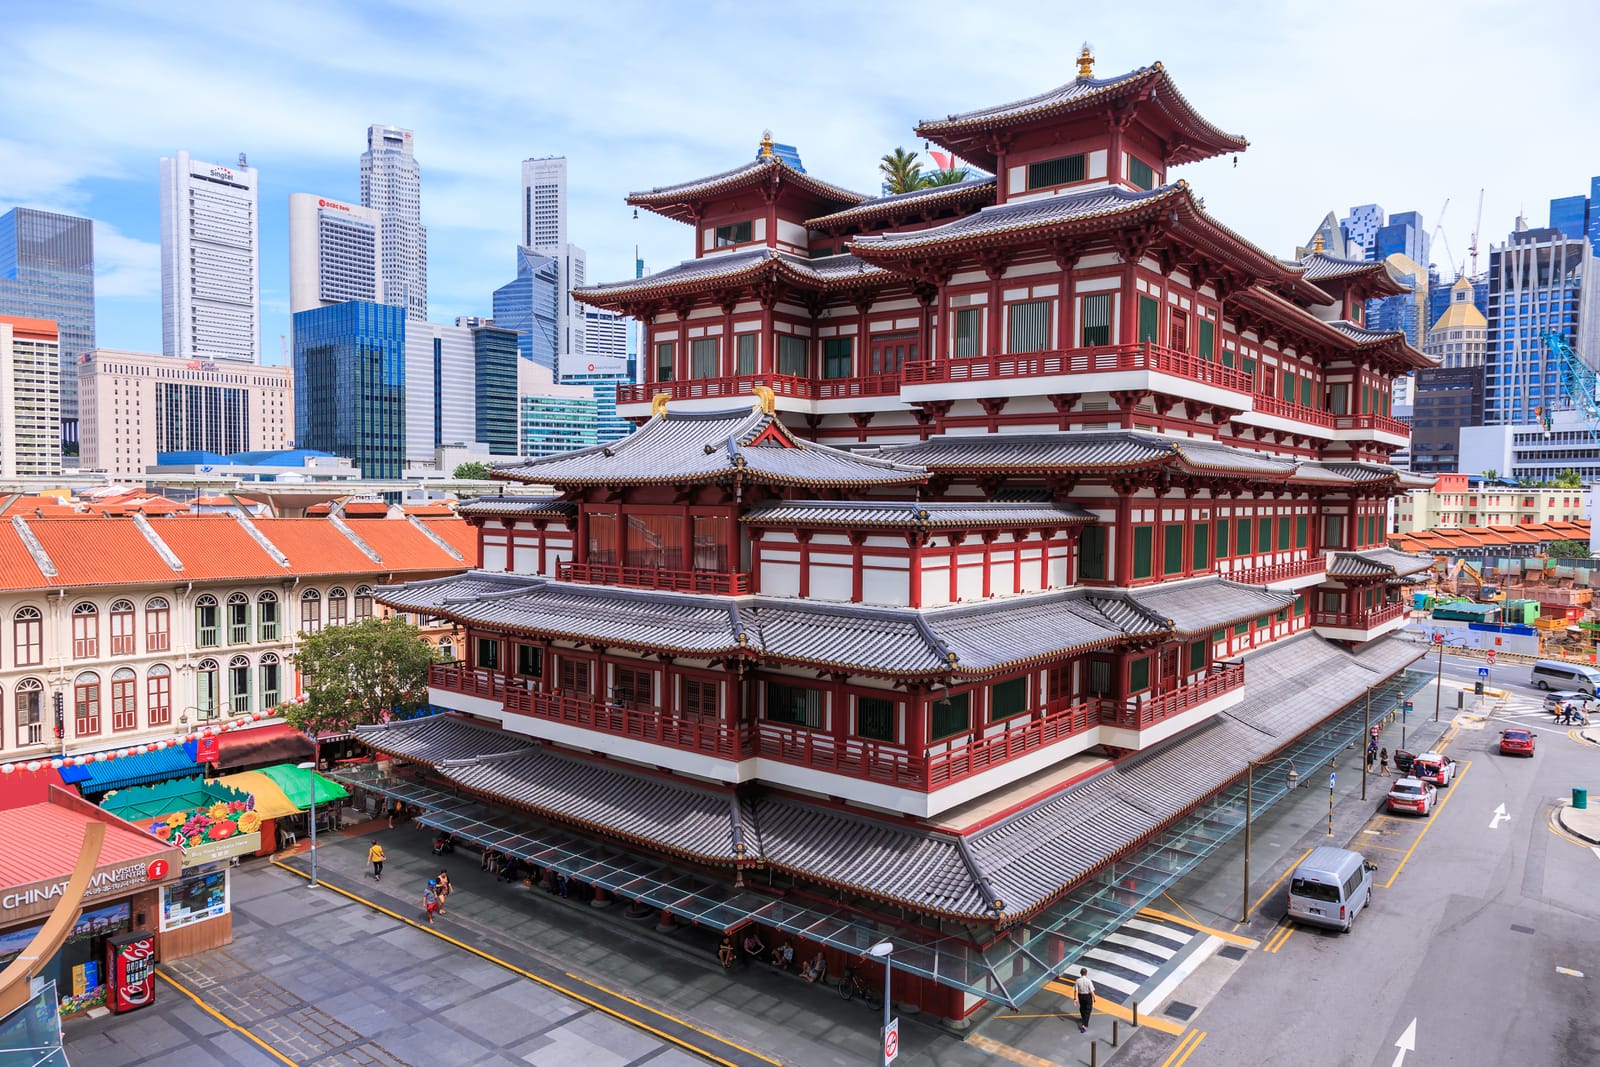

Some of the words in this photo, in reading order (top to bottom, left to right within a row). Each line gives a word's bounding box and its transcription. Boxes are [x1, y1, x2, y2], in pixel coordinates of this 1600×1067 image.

[209, 169, 234, 181] Singtel
[115, 863, 146, 875] VISITOR
[115, 870, 146, 882] CENTRE
[3, 869, 116, 909] CHINATWN
